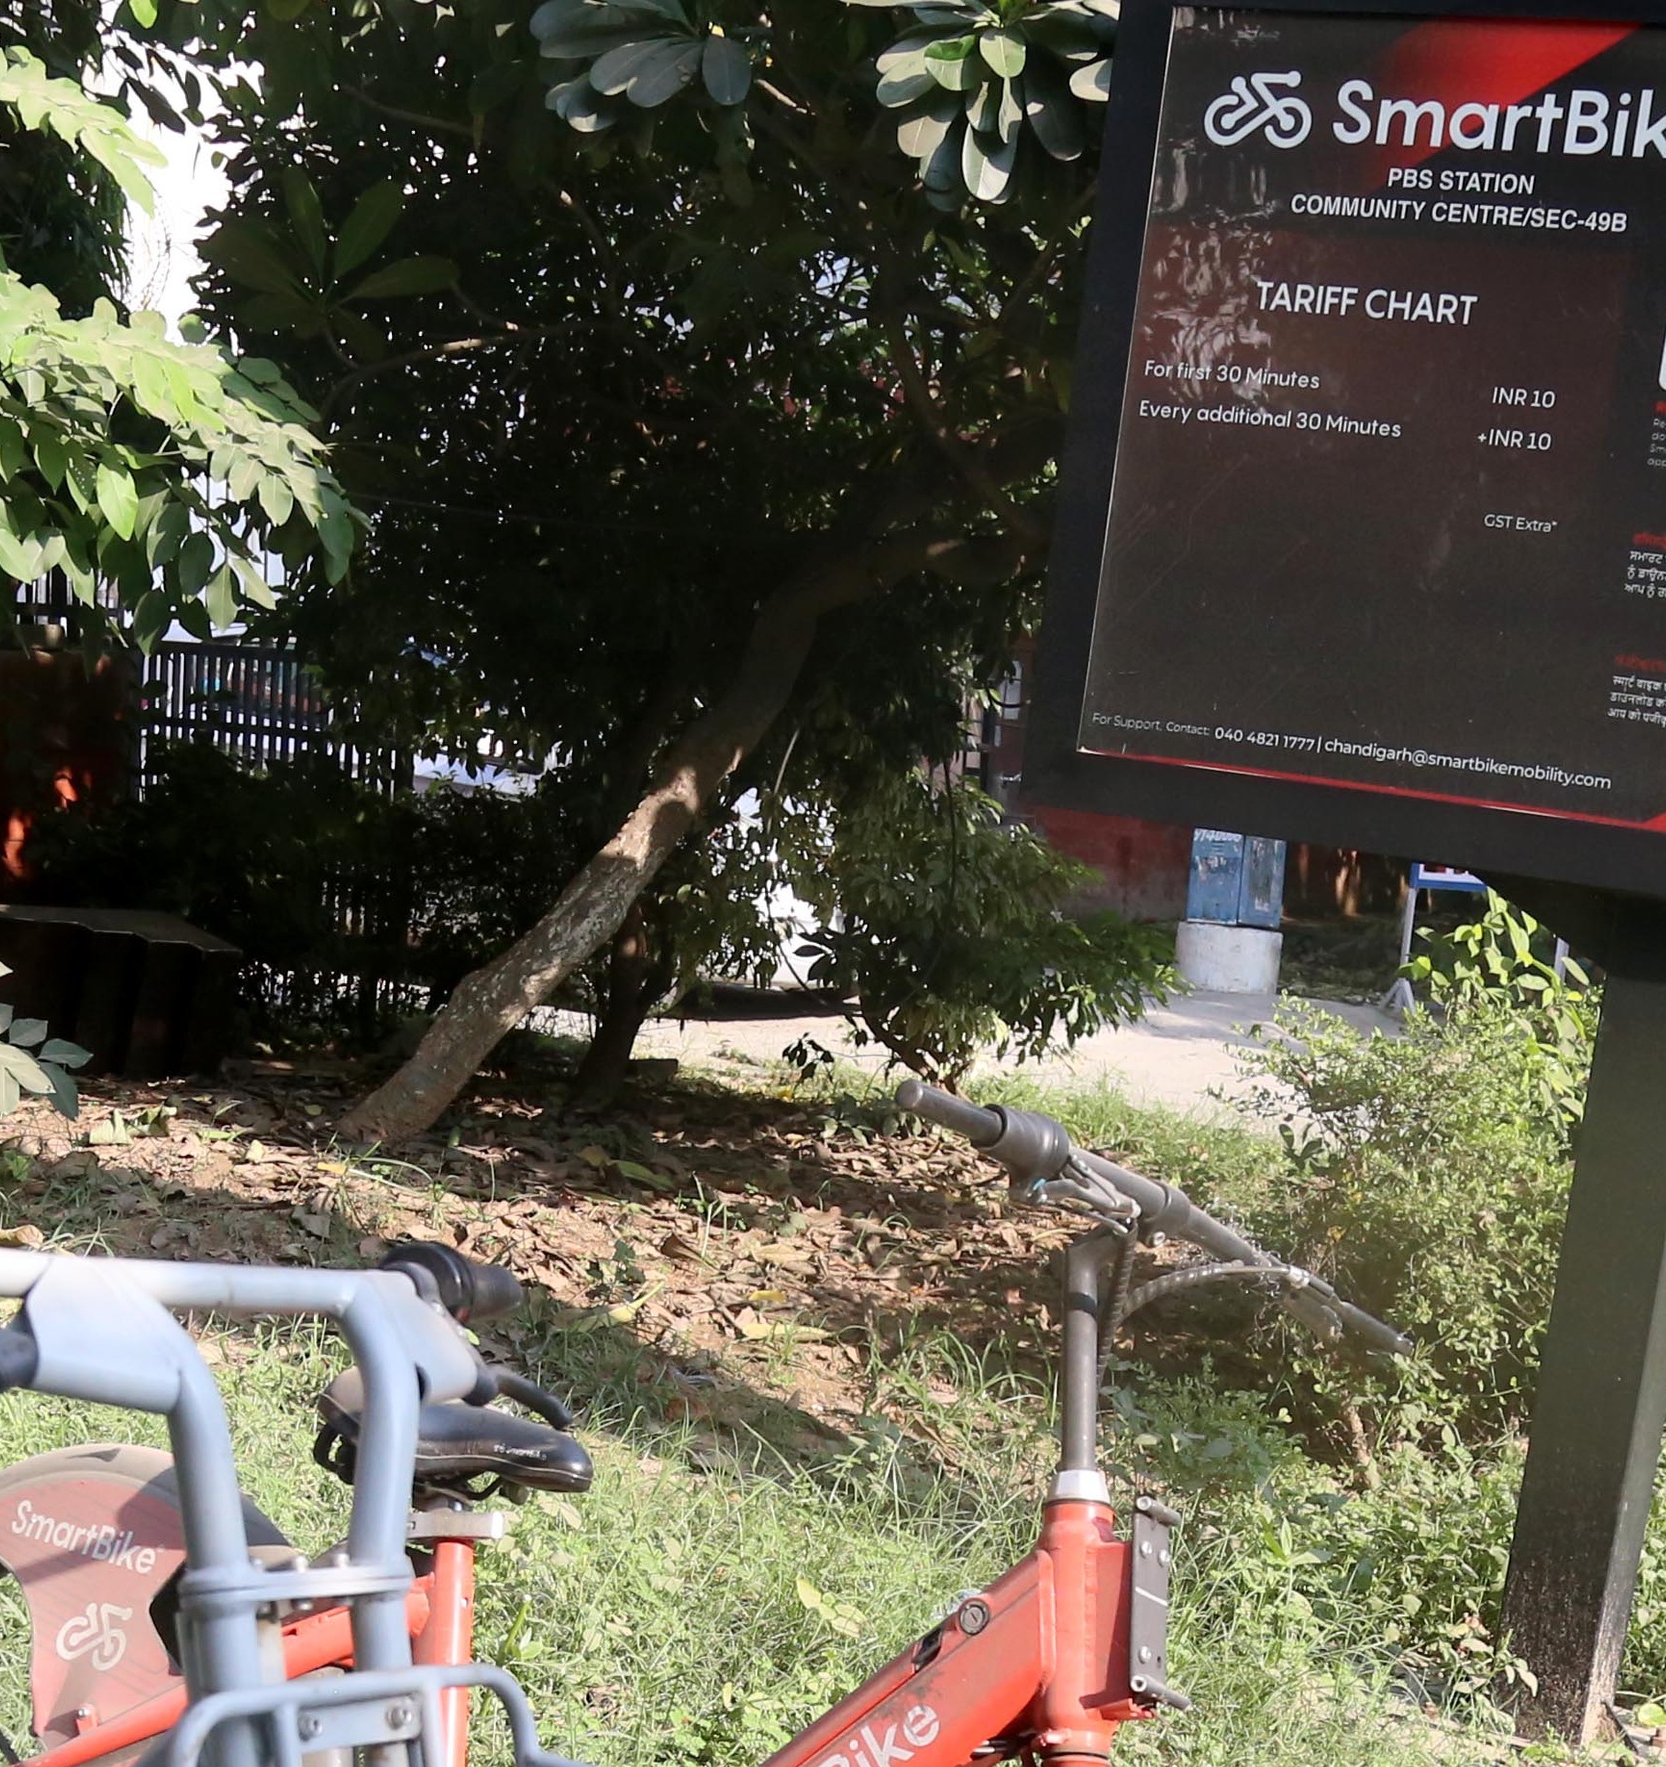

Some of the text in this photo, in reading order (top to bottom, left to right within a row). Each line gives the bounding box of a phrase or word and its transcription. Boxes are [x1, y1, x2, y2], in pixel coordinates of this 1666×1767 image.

[1387, 167, 1535, 195] PBS STATION
[1290, 194, 1629, 233] COMMUNITY CENTRE/SEC-49B
[1256, 280, 1479, 326] TARIFF CHART
[1144, 360, 1321, 390] For first 30 Minutes
[1491, 385, 1556, 410] INR 10
[1138, 400, 1403, 439] Every additional 30 Minutes
[1477, 427, 1552, 452] +INR 10
[1483, 512, 1514, 530] GST
[1092, 712, 1112, 725] For
[1214, 726, 1244, 743] 040
[1245, 729, 1280, 748] 4821
[1282, 733, 1316, 751] 1777
[1324, 736, 1612, 790] chandigarh@smartbikemobility.com
